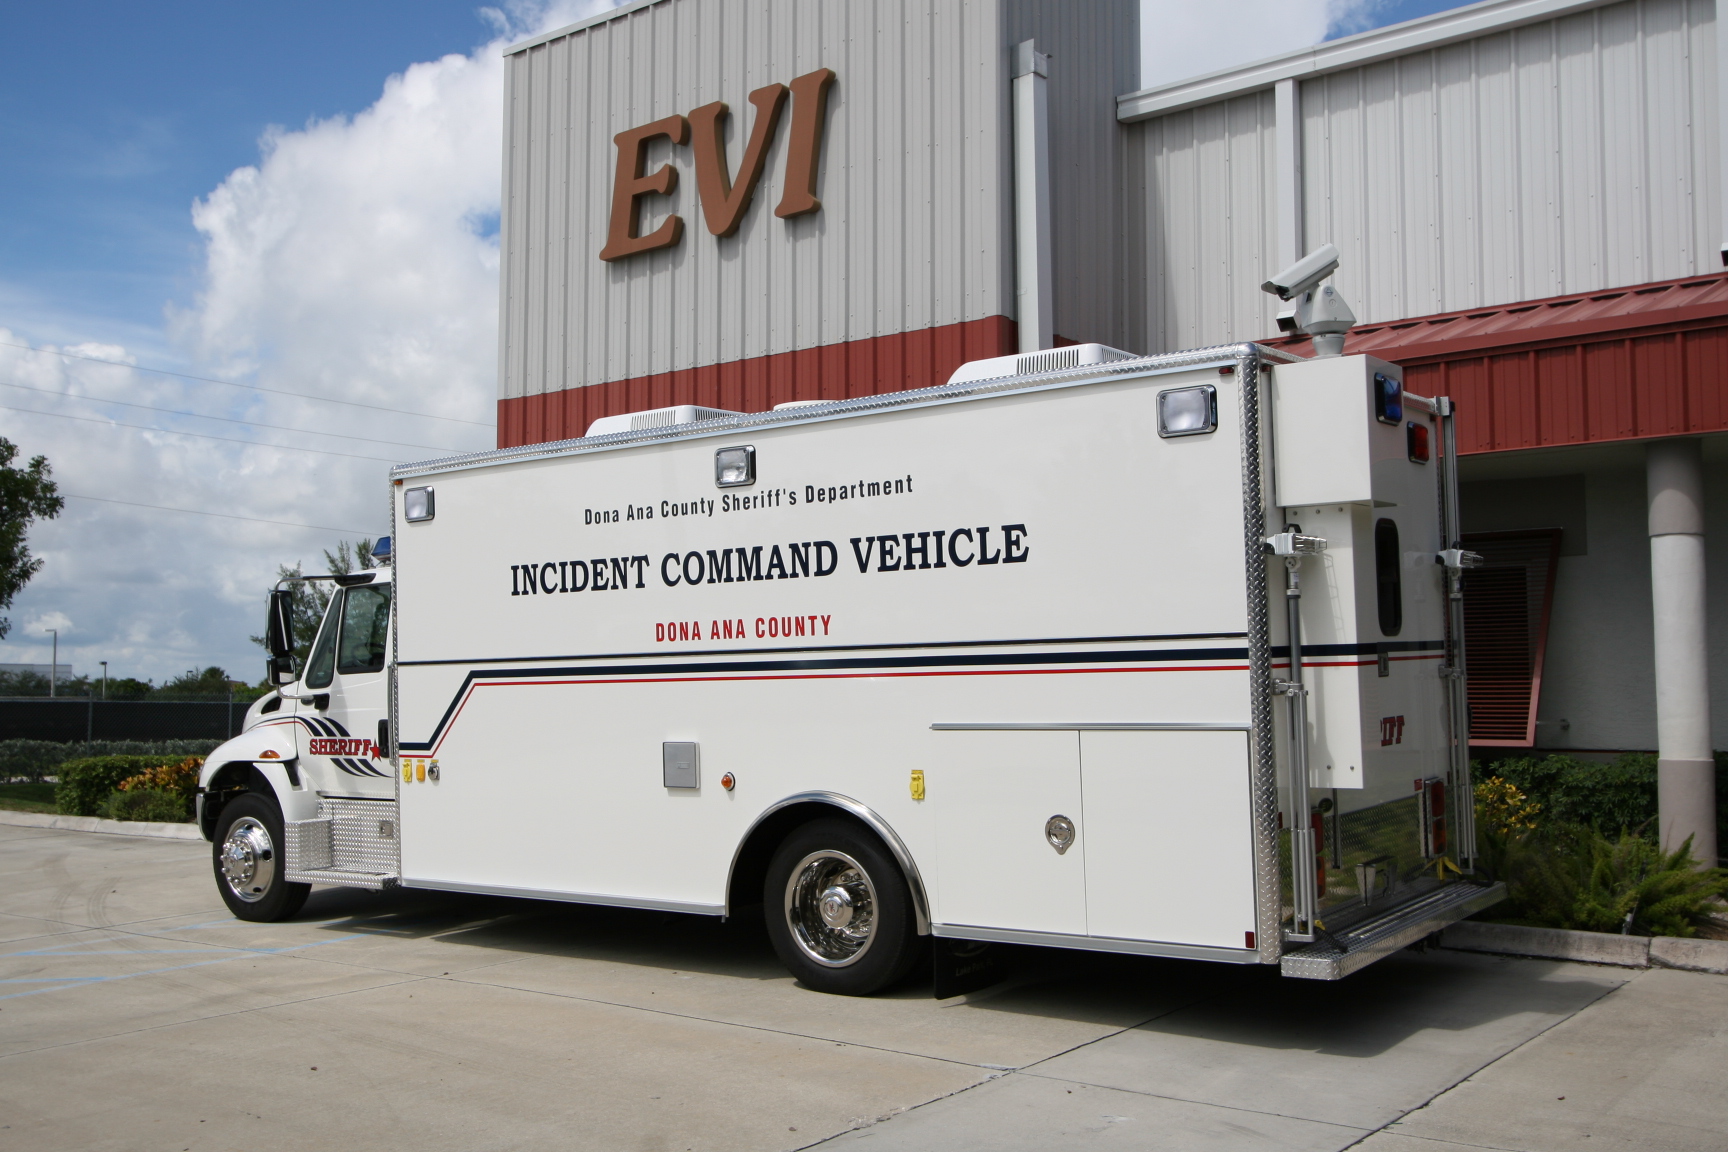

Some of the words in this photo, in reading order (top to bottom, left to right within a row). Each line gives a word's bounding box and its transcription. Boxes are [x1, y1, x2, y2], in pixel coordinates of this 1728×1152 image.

[600, 67, 836, 263] EVI
[584, 508, 620, 526] Dona
[626, 504, 654, 522] Ana
[660, 497, 715, 518] County
[722, 488, 797, 513] Sheriff's
[805, 474, 914, 504] Department
[510, 554, 651, 597] INCIDENT
[660, 540, 839, 588] COMMAND
[849, 523, 1030, 574] VEHICLE
[655, 621, 702, 643] DONA
[710, 619, 746, 640] ANA
[755, 614, 832, 639] COUNTY
[309, 738, 372, 756] SHERIFF
